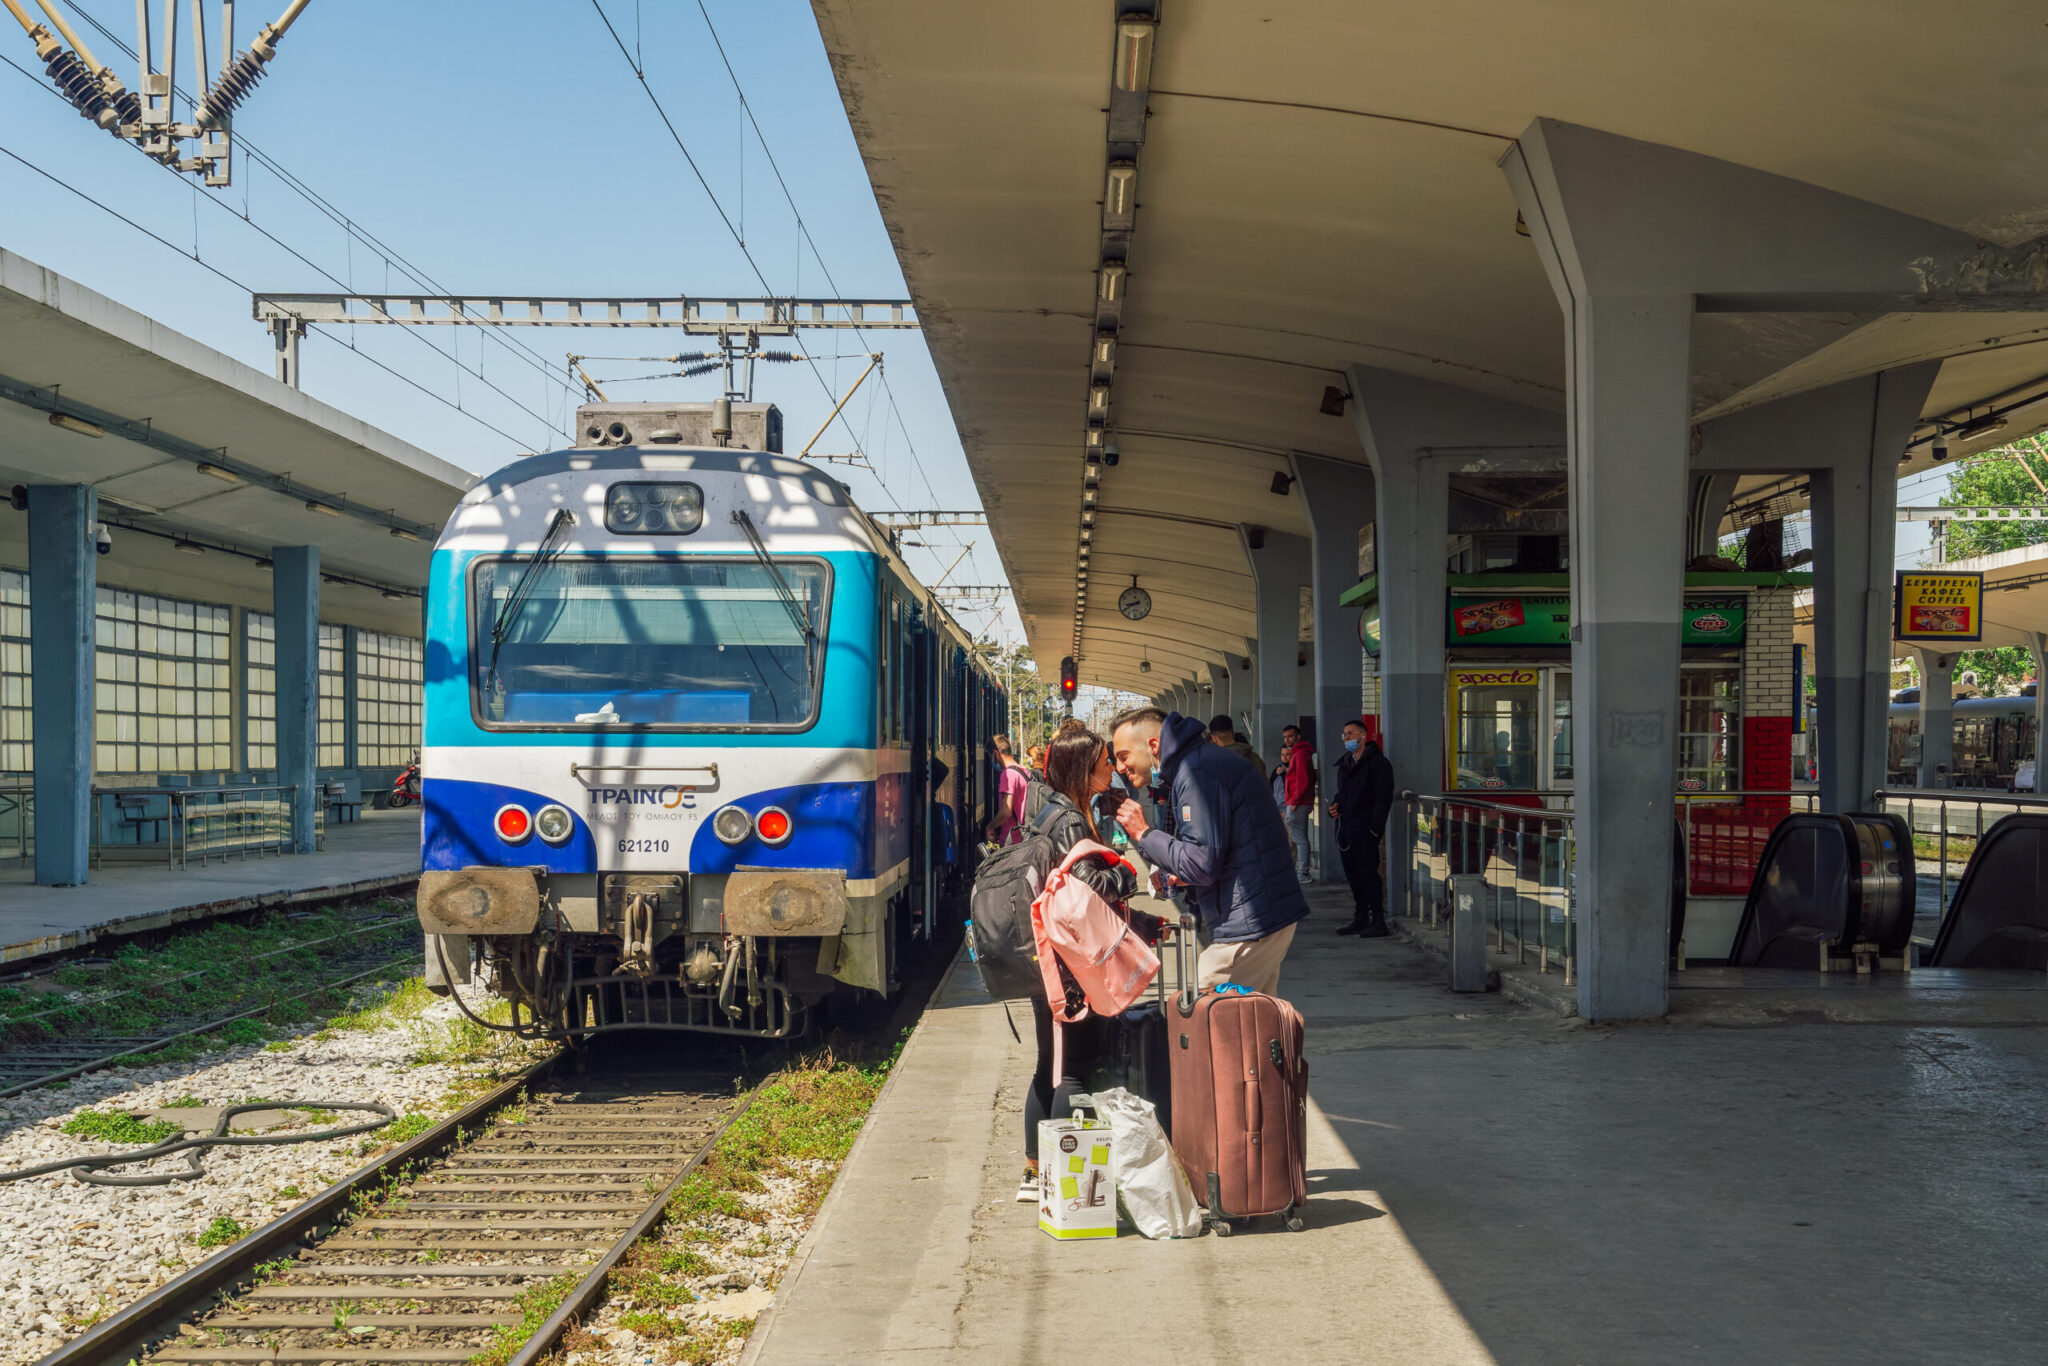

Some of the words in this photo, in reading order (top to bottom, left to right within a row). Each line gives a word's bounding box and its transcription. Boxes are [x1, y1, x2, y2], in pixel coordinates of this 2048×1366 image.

[1905, 579, 1978, 587] ΣΕΡΒΙΡΕΤΑΙ
[1921, 588, 1964, 596] ΚΑΦΕΣ
[1918, 596, 1966, 604] COFFEE
[1683, 599, 1745, 611] pecto
[1456, 670, 1535, 686] apecto
[586, 812, 617, 821] ΜΕΛΟΣ
[624, 812, 641, 821] ΤΟΥ
[688, 812, 698, 821] FS
[618, 839, 669, 853] 621210
